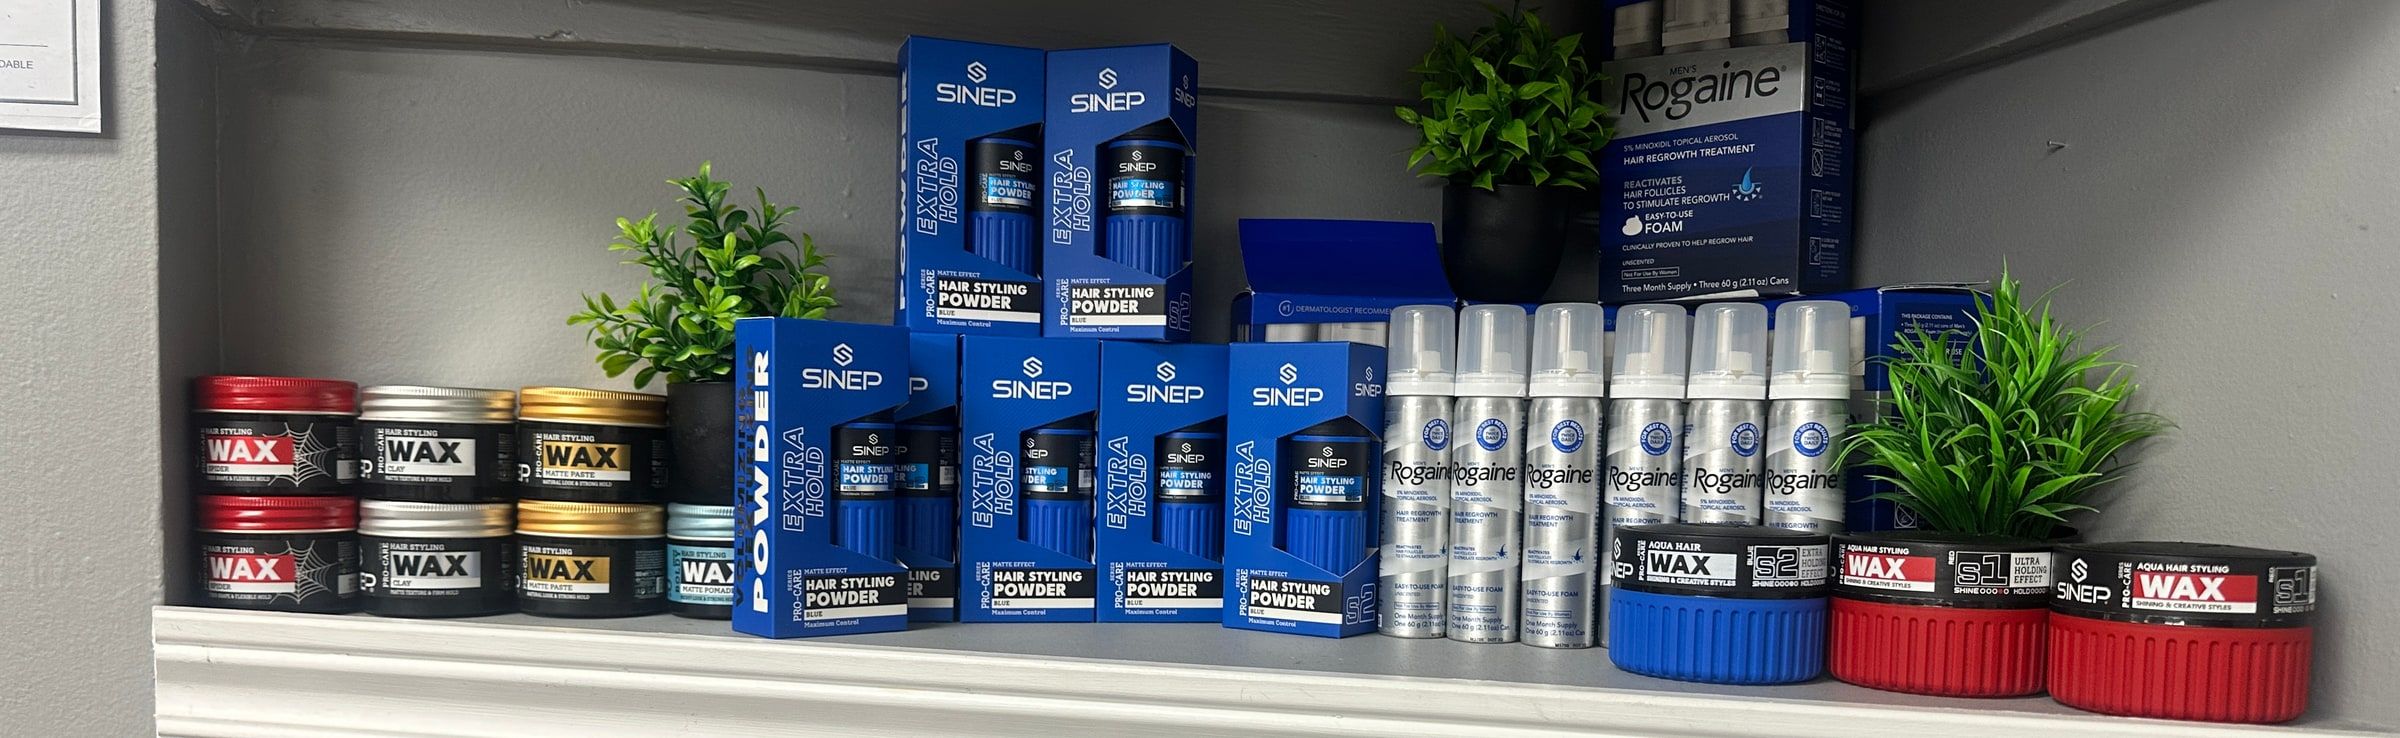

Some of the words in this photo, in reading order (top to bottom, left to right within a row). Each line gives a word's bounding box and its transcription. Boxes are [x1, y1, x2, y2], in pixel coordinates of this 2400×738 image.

[1669, 65, 1697, 76] MEN'S
[936, 83, 1016, 107] SINEP
[1070, 91, 1145, 113] SINEP
[1624, 144, 1634, 152] 5%
[1635, 141, 1671, 151] MINOXIDIL
[1673, 137, 1702, 147] TOPICAL
[1704, 133, 1739, 144] AEROSOL
[1623, 155, 1644, 165] HAIR
[1646, 149, 1698, 163] REGROWTH
[1700, 143, 1756, 158] TREATMENT
[999, 160, 1033, 173] SINEP
[1119, 162, 1157, 173] SINEP
[916, 137, 938, 236] EXTRA
[939, 157, 958, 224] HOLD
[1623, 189, 1643, 199] HAIR
[1644, 185, 1687, 198] FOLLICLES
[1624, 176, 1682, 189] REACTIVATES
[1052, 148, 1074, 245] EXTRA
[1072, 166, 1091, 231] HOLD
[1623, 202, 1635, 210] TO
[1636, 197, 1680, 209] STIMULATE
[1681, 193, 1730, 205] REGROWTH
[1645, 210, 1694, 221] EASY-TO-USE
[1645, 221, 1683, 234] FOAM
[1622, 243, 1655, 251] CLINICALLY
[1655, 241, 1681, 249] PROVEN
[1691, 239, 1708, 247] HELP
[1708, 237, 1737, 245] REGROW
[1737, 235, 1754, 243] HAIR
[925, 269, 935, 318] PRO-CARE
[938, 280, 969, 292] HAIR
[973, 283, 1028, 295] STYLING
[1071, 288, 1100, 299] HAIR
[1103, 287, 1154, 298] STYLING
[1622, 284, 1642, 293] Three
[1643, 283, 1666, 292] Month
[1667, 281, 1692, 292] Supply
[1699, 280, 1720, 289] Three
[1721, 279, 1732, 288] 60
[1732, 281, 1738, 289] g
[1769, 277, 1789, 286] Cans
[938, 292, 1012, 309] POWDER
[1060, 279, 1069, 326] PRO-CARE
[1071, 300, 1139, 313] POWDER
[1296, 305, 1353, 314] DERMATOLOGIST
[802, 368, 882, 390] SINEP
[992, 380, 1072, 400] SINEP
[1127, 384, 1204, 404] SINEP
[1252, 387, 1324, 407] SINEP
[1354, 382, 1382, 398] SINEP
[384, 428, 403, 436] HAIR
[403, 429, 438, 437] STYLING
[543, 433, 560, 441] HAIR
[561, 434, 595, 442] STYLING
[207, 439, 280, 462] WAX
[387, 440, 463, 464] WAX
[535, 433, 543, 478] PRO-CARE
[545, 444, 618, 468] WAX
[852, 445, 889, 456] SINEP
[1167, 453, 1205, 464] SINEP
[387, 465, 405, 473] CLAY
[1308, 458, 1348, 469] SINEP
[570, 471, 595, 479] PASTE
[753, 350, 769, 613] POWDER
[783, 427, 804, 532] EXTRA
[805, 447, 824, 517] HOLD
[843, 474, 889, 484] POWDER
[972, 432, 994, 529] EXTRA
[994, 450, 1014, 515] HOLD
[1107, 435, 1129, 529] EXTRA
[1453, 461, 1516, 487] Rogaine
[1527, 464, 1592, 489] Rogaine
[1609, 466, 1678, 492] Rogaine
[1766, 469, 1838, 495] Rogaine
[1128, 453, 1147, 517] HOLD
[1160, 480, 1204, 489] POWDER
[1233, 440, 1255, 536] EXTRA
[1252, 458, 1272, 524] HOLD
[1300, 484, 1346, 495] POWDER
[390, 543, 409, 551] HAIR
[1648, 541, 1673, 550] AQUA
[1675, 543, 1701, 551] HAIR
[1847, 544, 1862, 552] AQUA
[1879, 547, 1910, 555] STYLING
[210, 557, 281, 581] WAX
[382, 542, 390, 588] PRO-CARE
[392, 554, 468, 577] WAX
[530, 557, 595, 581] WAX
[1650, 553, 1711, 575] WAX
[1848, 554, 1906, 580] WAX
[2014, 557, 2040, 565] ULTRA
[2014, 565, 2047, 574] HOLDING
[2136, 562, 2164, 571] AQUA
[2165, 563, 2188, 572] HAIR
[2190, 564, 2230, 573] STYLING
[528, 582, 549, 590] MATTE
[806, 579, 837, 591] HAIR
[841, 576, 895, 589] STYLING
[981, 562, 990, 609] PRO-CARE
[994, 571, 1025, 582] HAIR
[1028, 571, 1083, 582] STYLING
[1115, 562, 1124, 608] PRO-CARE
[1127, 571, 1157, 582] HAIR
[1160, 571, 1213, 582] STYLING
[2014, 575, 2043, 583] EFFECT
[2121, 562, 2132, 608] PRO-CARE
[793, 569, 802, 622] PRO-CARE
[994, 583, 1066, 597] POWDER
[1127, 583, 1197, 597] POWDER
[1239, 568, 1249, 616] PRO-CARE
[1250, 579, 1279, 592] HAIR
[1281, 581, 1331, 596] STYLING
[2056, 581, 2111, 604] SINEP
[2139, 574, 2226, 601] WAX
[806, 590, 879, 608] POWDER
[1250, 591, 1316, 610] POWDER
[2173, 602, 2207, 610] CREATIVE
